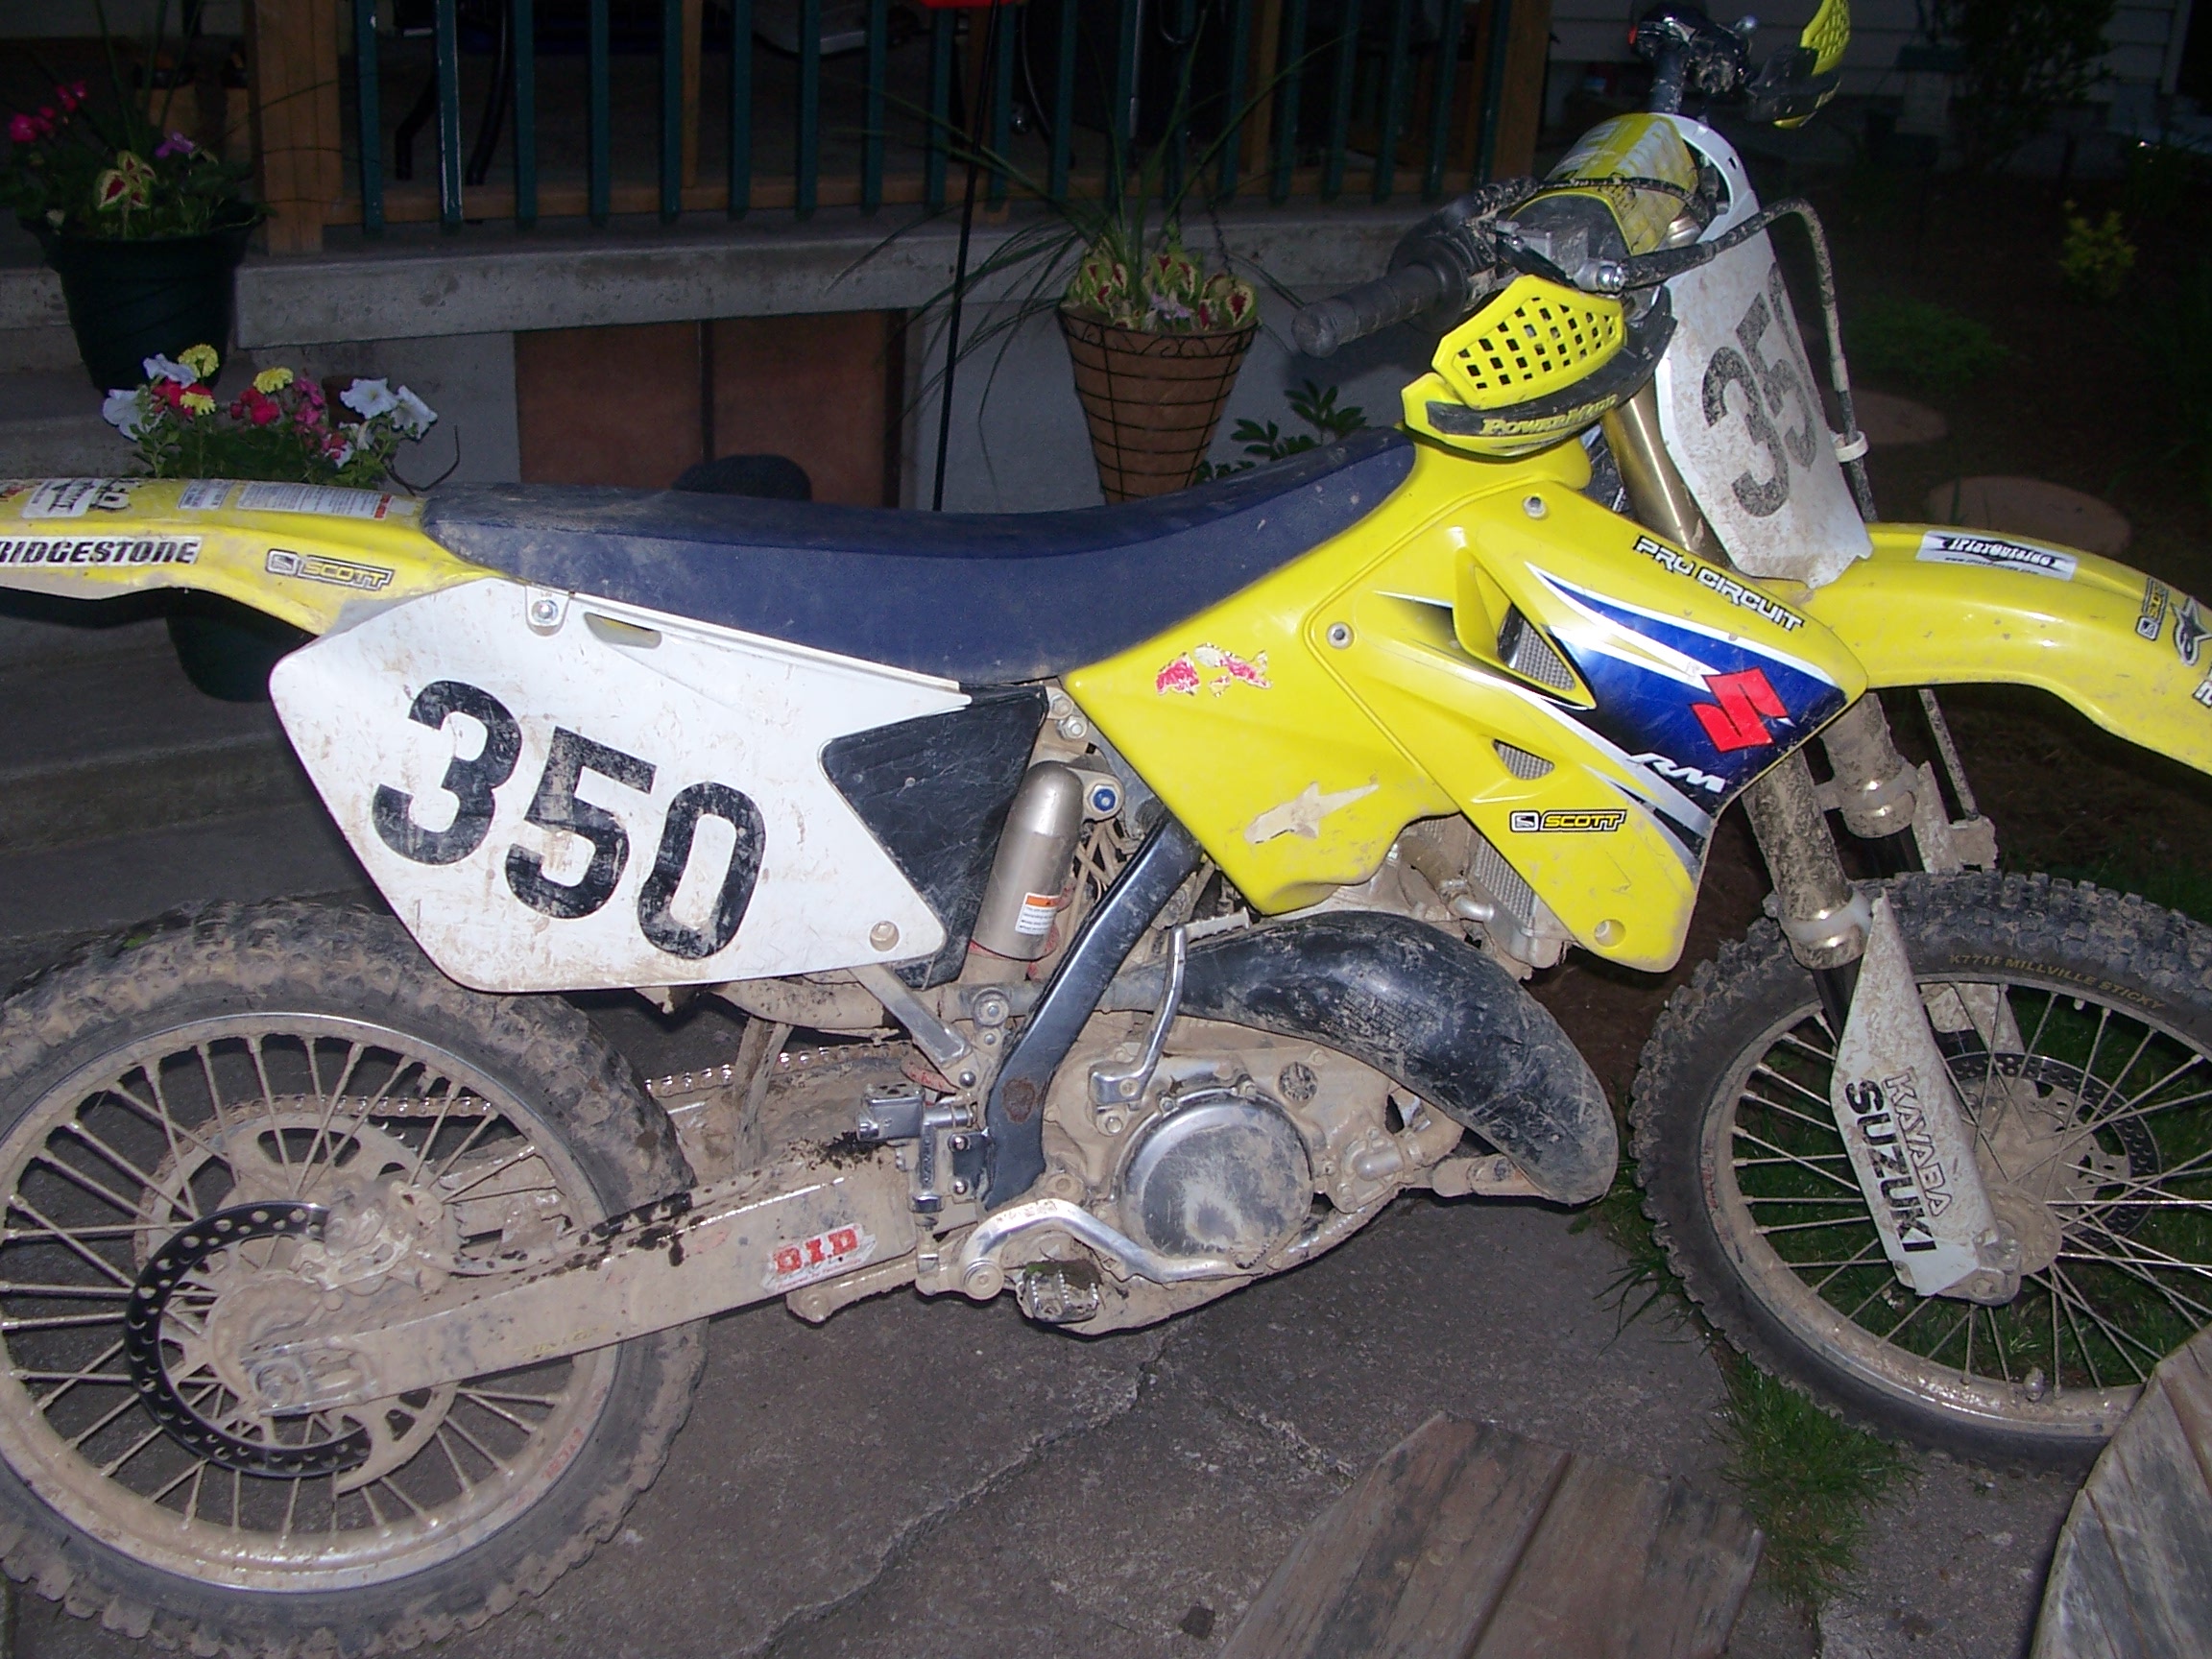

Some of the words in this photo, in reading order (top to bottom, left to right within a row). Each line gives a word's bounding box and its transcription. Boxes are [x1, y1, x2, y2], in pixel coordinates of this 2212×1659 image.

[301, 560, 387, 586] SCOTT
[1633, 535, 1695, 577] PRO
[1695, 565, 1804, 633] CIRCUIT
[372, 679, 767, 961] 350
[1543, 812, 1623, 830] SCOTT
[2004, 957, 2098, 986] MILLVILLE
[2098, 979, 2166, 1009] STICKY
[1844, 1078, 1937, 1253] SUZUKI
[1881, 1065, 1954, 1219] KAYABA
